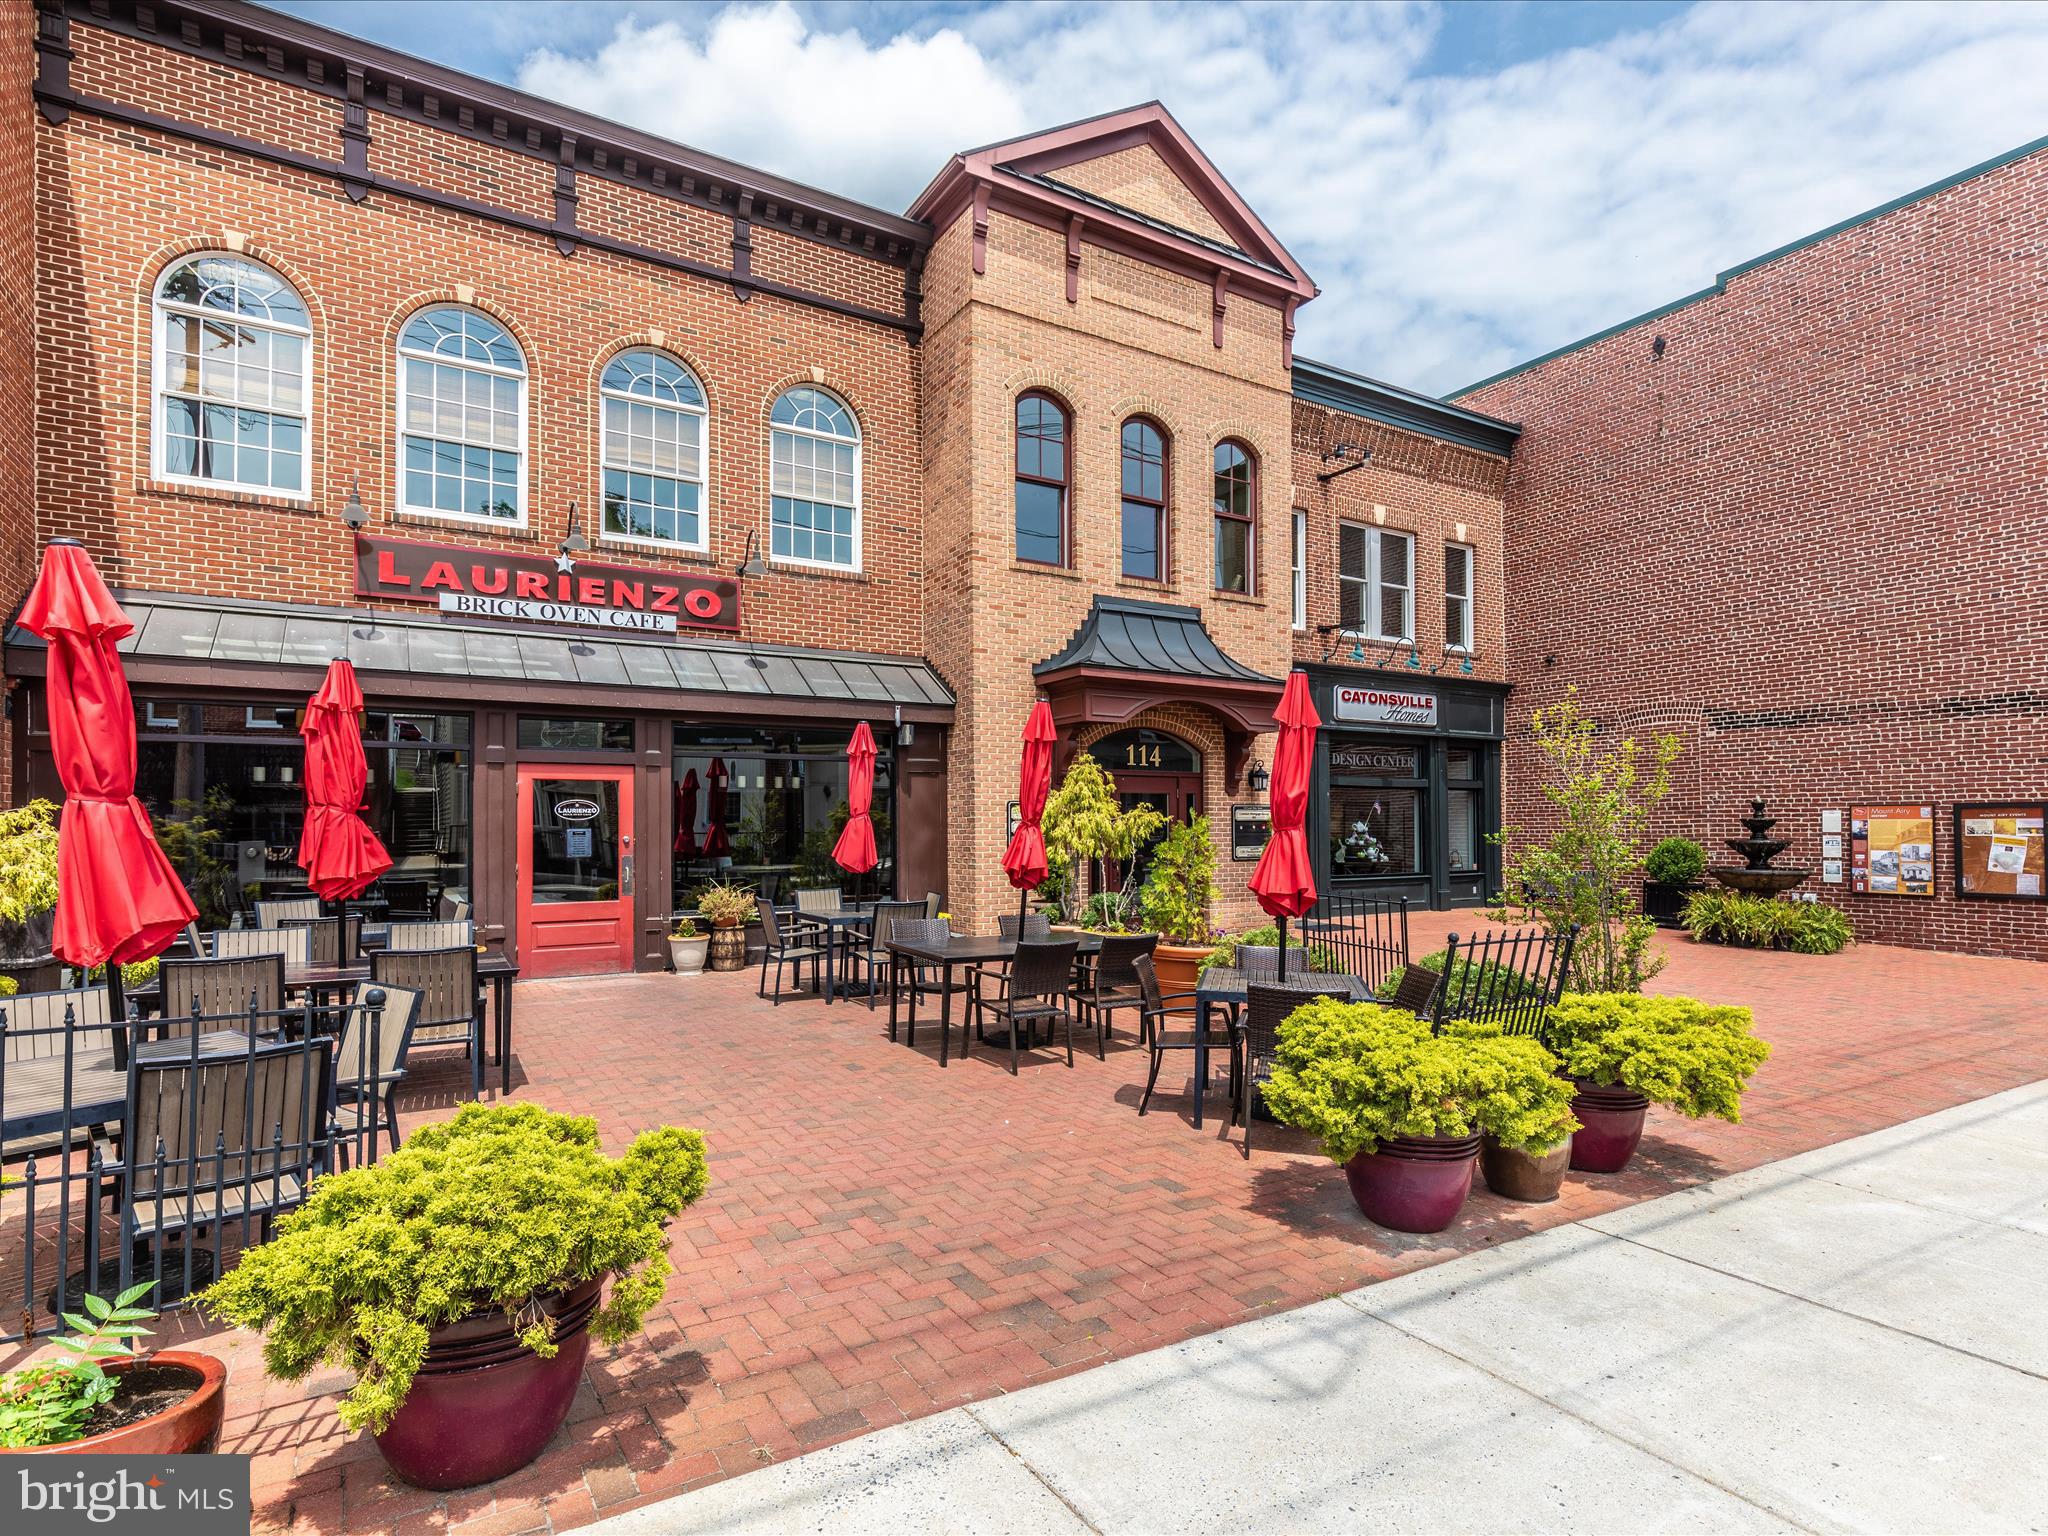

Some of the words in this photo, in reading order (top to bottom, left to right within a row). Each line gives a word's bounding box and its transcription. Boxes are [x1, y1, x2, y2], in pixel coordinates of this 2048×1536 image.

[377, 550, 723, 619] LAURIENZO
[456, 595, 532, 617] BRICK
[540, 603, 602, 625] OVEN
[609, 610, 665, 631] CAFE
[1341, 690, 1433, 708] CATONSVILLE
[1380, 704, 1430, 723] Homes
[1126, 743, 1161, 767] 114
[1332, 753, 1372, 767] DESIGN
[1373, 755, 1414, 767] CENTER
[1895, 807, 1911, 815] Airy
